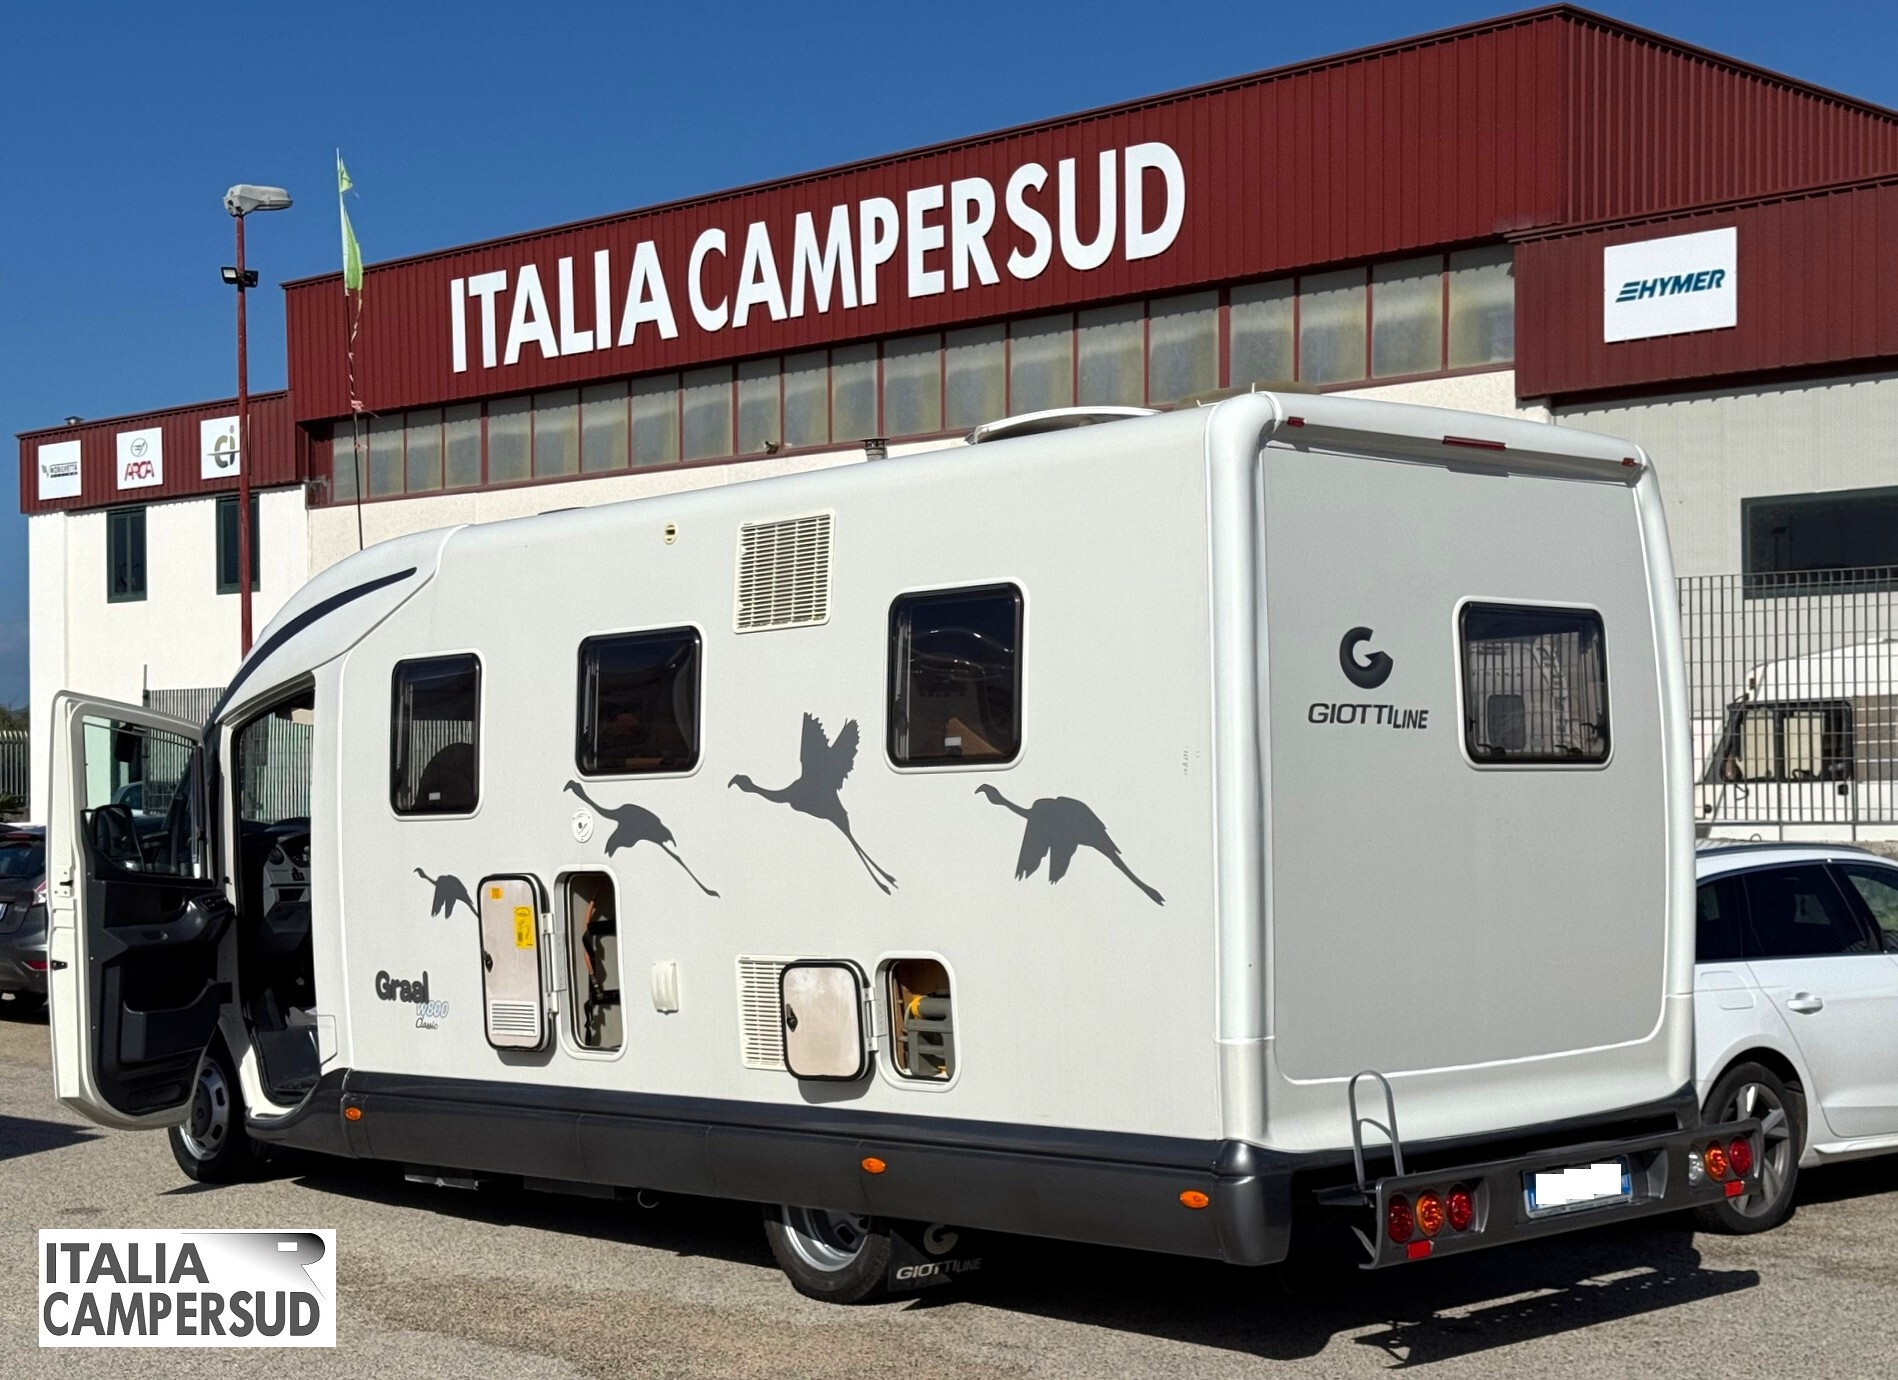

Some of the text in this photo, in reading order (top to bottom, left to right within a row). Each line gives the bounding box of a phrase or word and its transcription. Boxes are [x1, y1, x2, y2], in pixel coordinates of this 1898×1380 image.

[450, 142, 1186, 373] ITALIA CAMPERSUD
[1637, 268, 1726, 301] HYMER
[124, 460, 155, 481] ARCA
[375, 970, 430, 1004] Graal
[416, 1000, 449, 1018] W800
[415, 1016, 439, 1030] Classic
